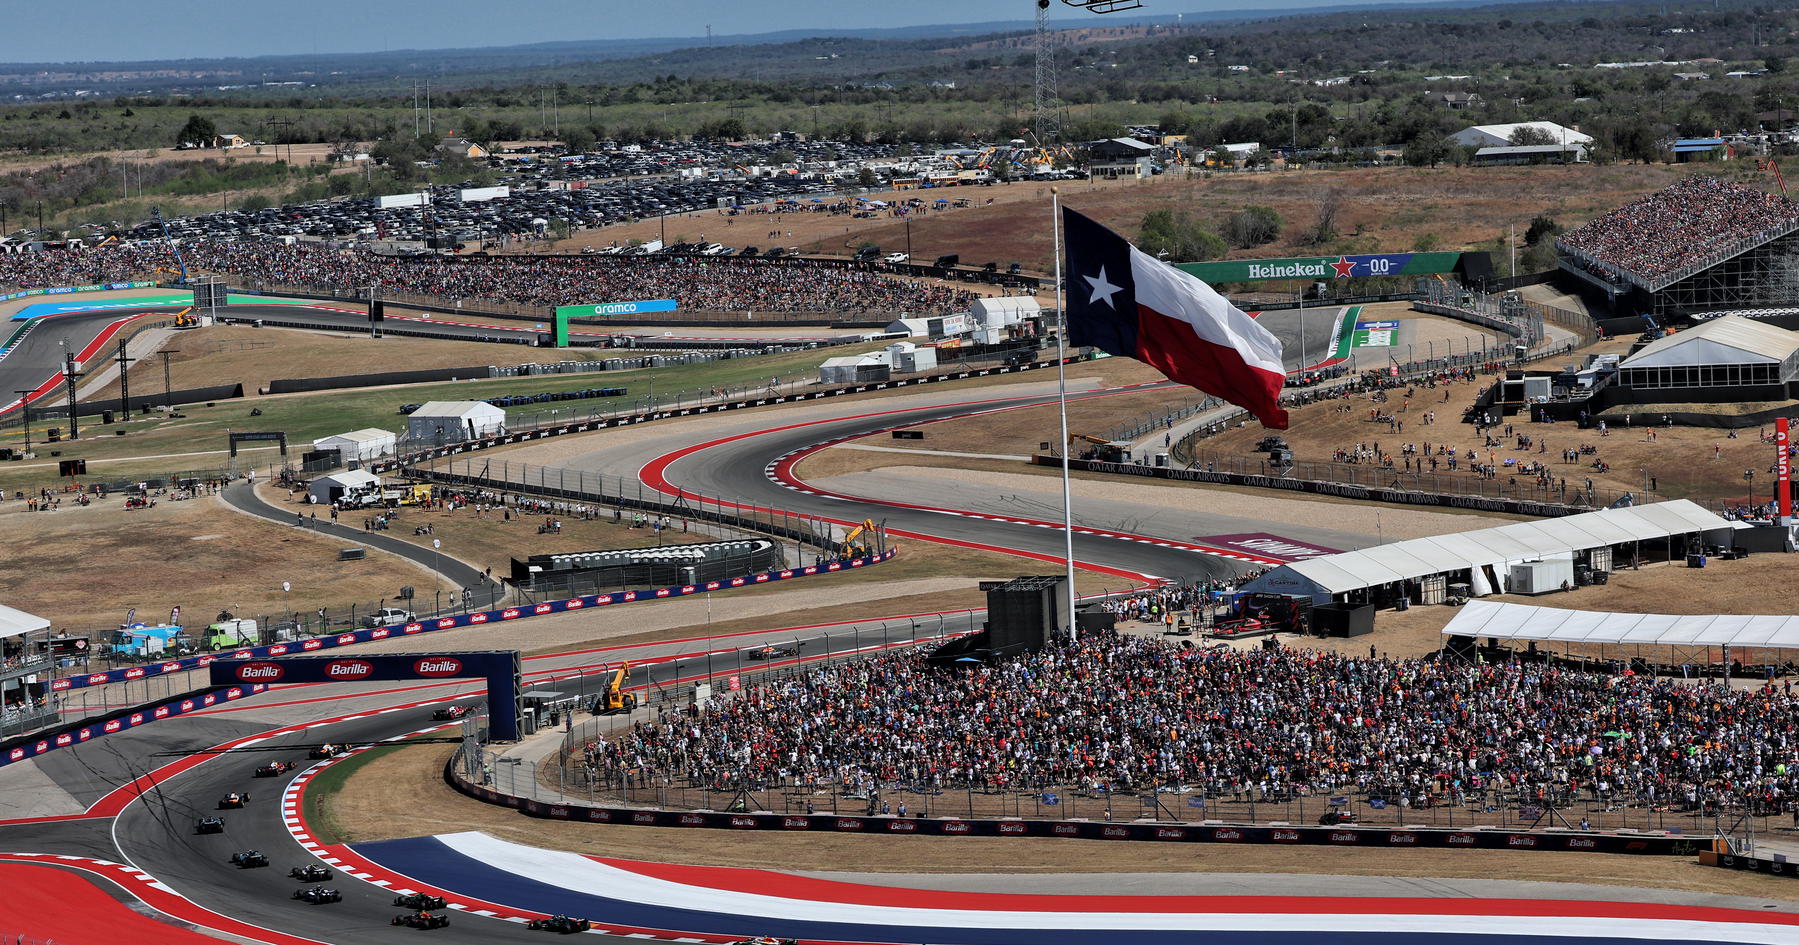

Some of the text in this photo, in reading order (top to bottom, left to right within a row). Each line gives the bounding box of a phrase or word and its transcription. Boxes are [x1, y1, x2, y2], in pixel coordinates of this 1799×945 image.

[1248, 263, 1326, 278] Heineken
[1371, 260, 1389, 273] 0.0
[595, 304, 636, 314] aramco
[1088, 462, 1153, 476] QATAR AIRWAYS
[1167, 470, 1230, 482] QATAR AIRWAYS
[1244, 476, 1304, 490] QATAR AIRWAYS
[1382, 492, 1406, 502] QATAR
[1450, 498, 1506, 512] QATAR AIRWAYS
[242, 667, 278, 677] Barilla
[331, 664, 368, 674] Barilla
[420, 662, 458, 672] Barilla
